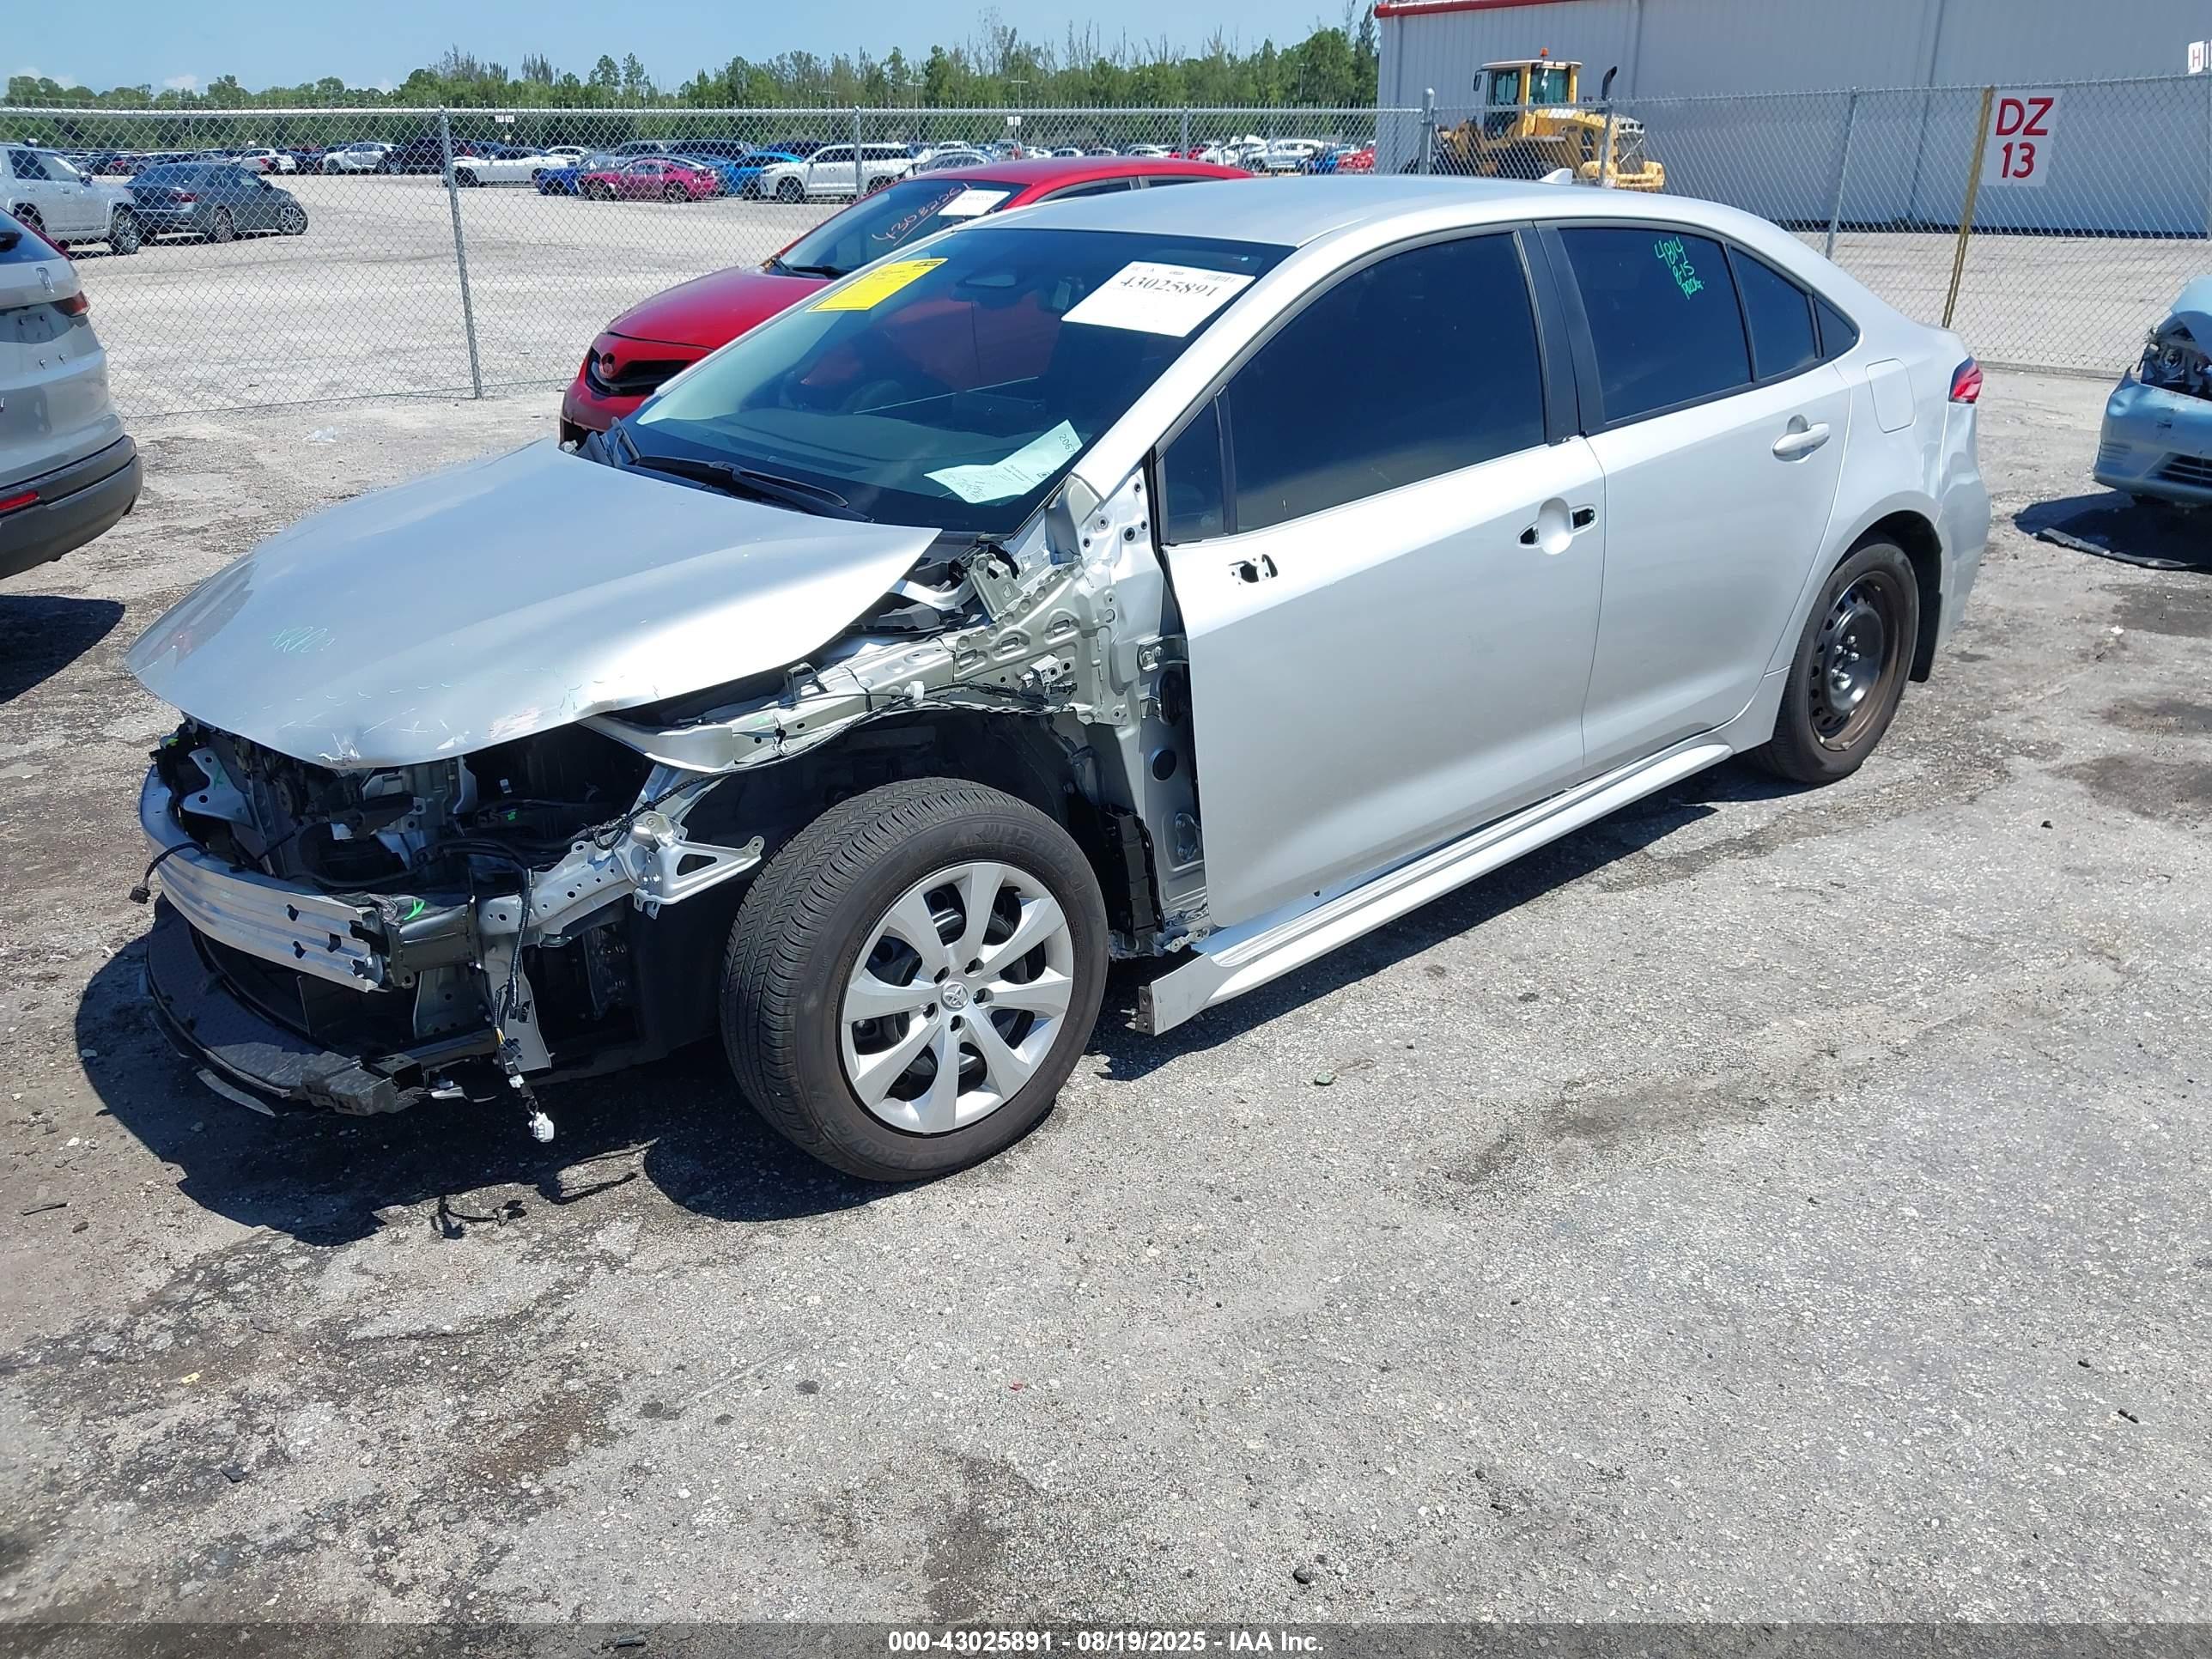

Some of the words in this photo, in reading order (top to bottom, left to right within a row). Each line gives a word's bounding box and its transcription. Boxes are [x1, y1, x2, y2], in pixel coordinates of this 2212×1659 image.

[1996, 97, 2055, 137] DZ
[2002, 142, 2036, 179] 13
[1654, 236, 1687, 269] 4814
[1120, 275, 1220, 297] 43025891
